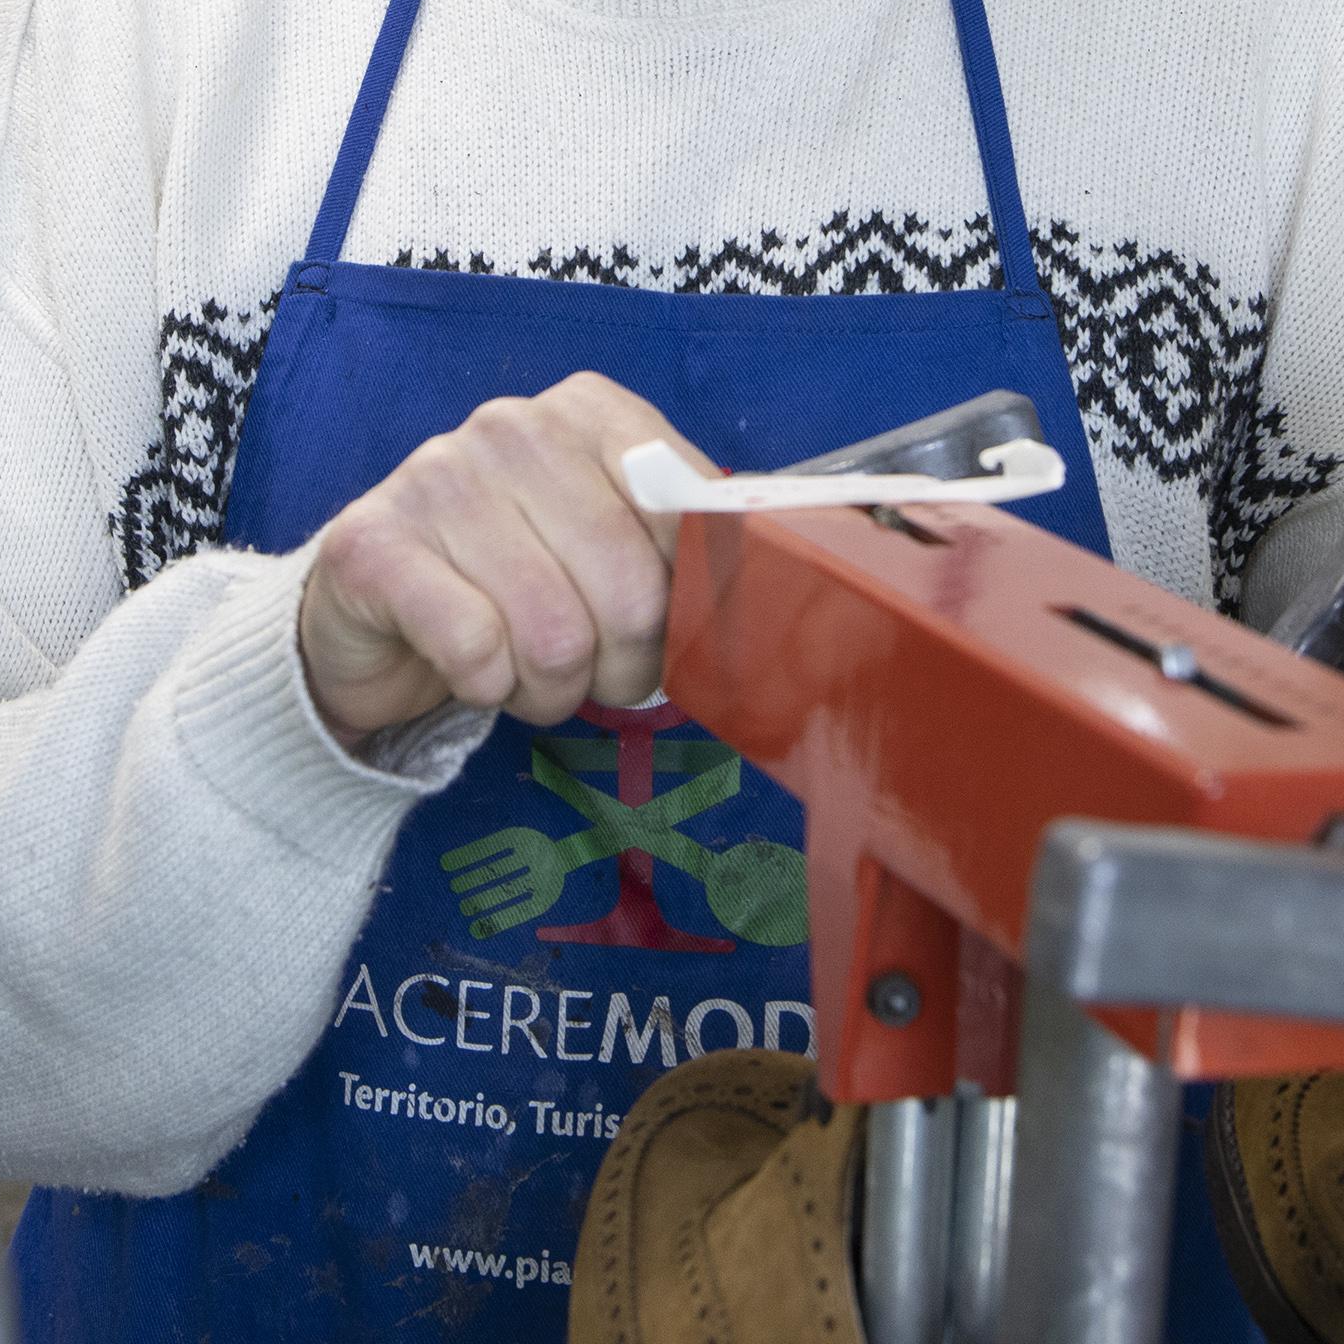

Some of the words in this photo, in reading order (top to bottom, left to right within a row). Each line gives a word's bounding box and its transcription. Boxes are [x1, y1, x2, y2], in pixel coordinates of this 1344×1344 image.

[339, 1070, 516, 1135] Territorio,
[528, 1100, 624, 1139] Turis
[409, 1243, 572, 1289] www.pia
